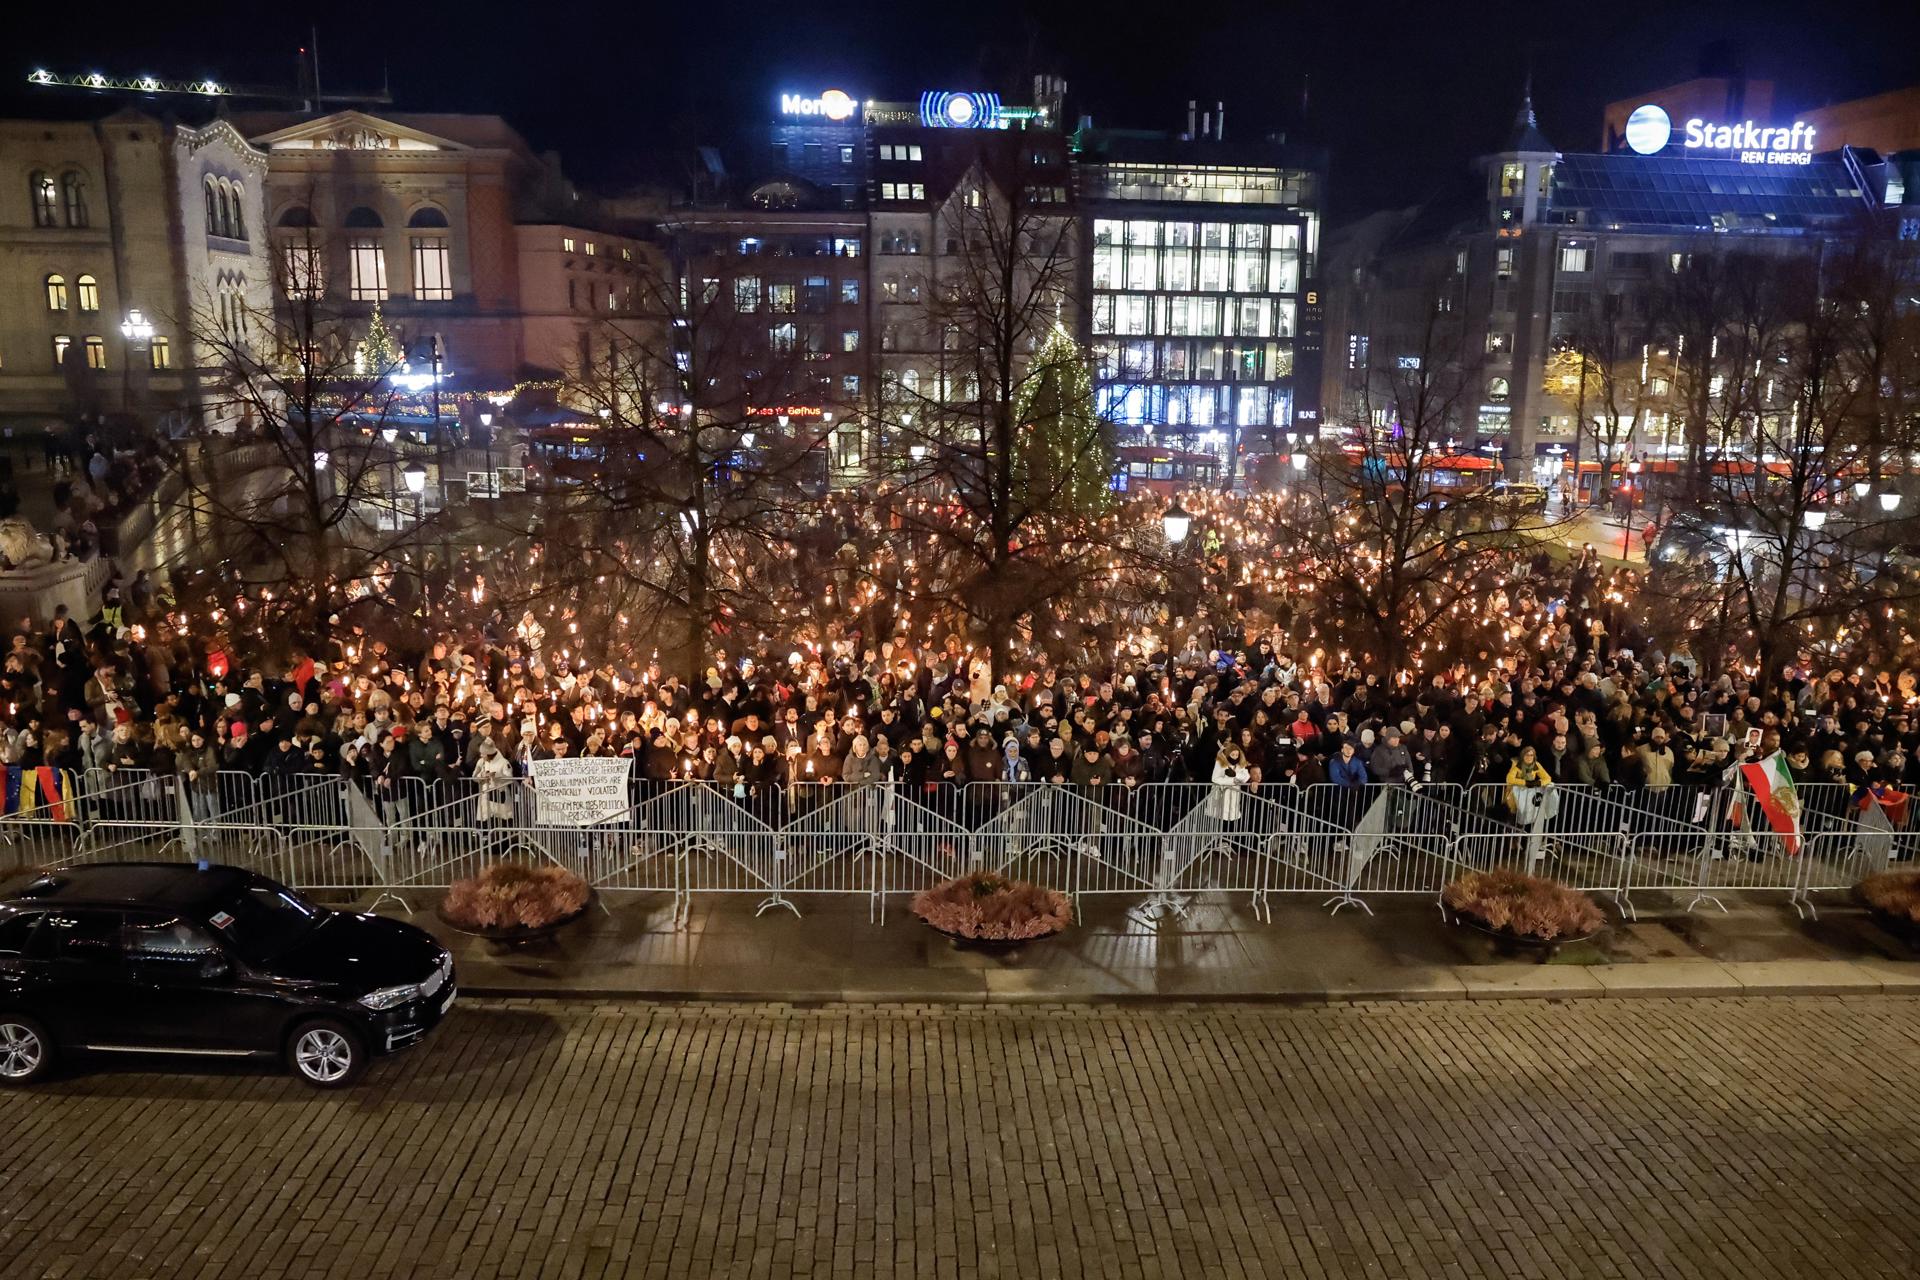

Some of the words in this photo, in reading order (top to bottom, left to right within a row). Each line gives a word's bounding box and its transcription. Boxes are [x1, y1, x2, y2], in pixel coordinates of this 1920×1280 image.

[782, 93, 858, 116] Monr
[1684, 118, 1817, 151] Statkraft
[1741, 151, 1765, 164] REN
[1767, 151, 1812, 165] ENERGI
[1306, 291, 1317, 304] 6
[1349, 334, 1357, 369] HOTEL
[609, 776, 621, 785] ARE
[587, 785, 618, 795] VIOLATED
[572, 801, 584, 810] FOR
